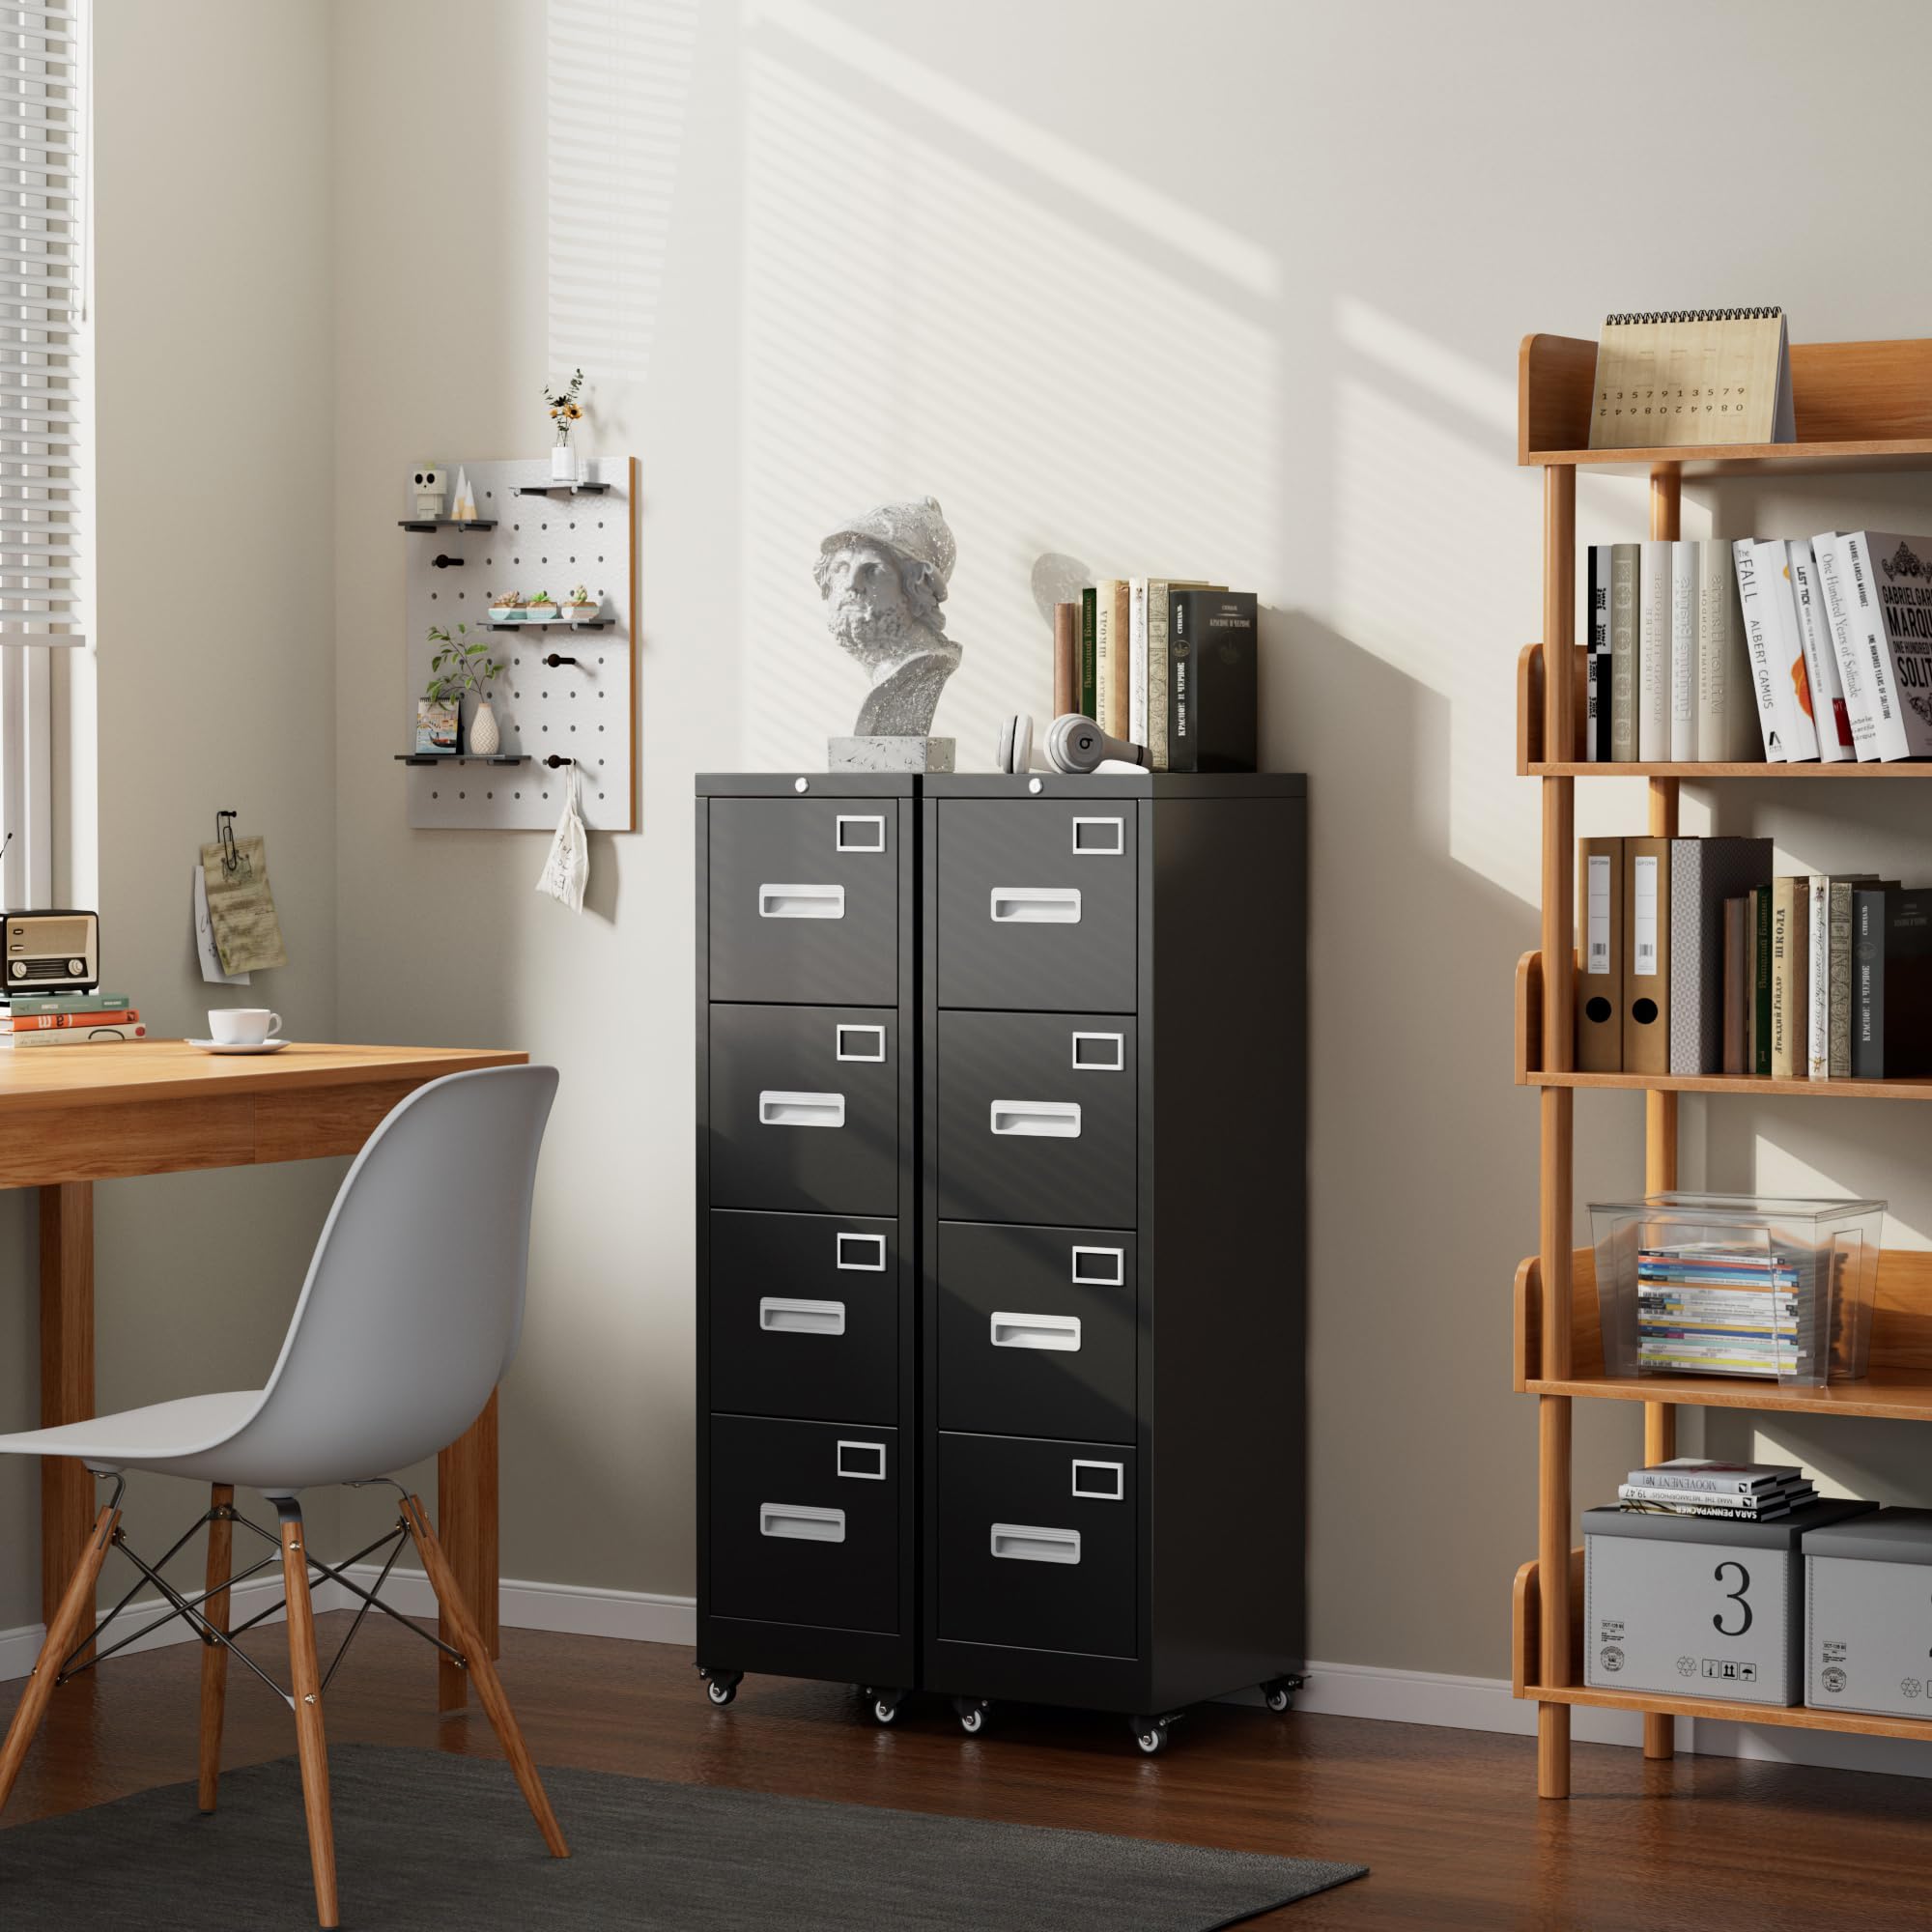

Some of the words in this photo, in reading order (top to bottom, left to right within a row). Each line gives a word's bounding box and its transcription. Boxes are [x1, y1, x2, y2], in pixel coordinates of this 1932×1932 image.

[1797, 566, 1807, 585] LAST
[1822, 554, 1833, 574] One
[1739, 559, 1758, 603] FALL
[1801, 588, 1810, 605] TICK
[1827, 576, 1846, 618] Hundred
[1882, 585, 1917, 605] GABRIEL
[1916, 587, 1932, 607] GAR
[1098, 611, 1107, 657] ШКОЛА
[1750, 620, 1767, 665] ALBERT
[1905, 641, 1930, 655] HUNDRED
[1758, 669, 1774, 709] CAMUS
[1843, 660, 1861, 697] Solitude
[1880, 696, 1891, 719] SOLITUDE
[1776, 909, 1785, 958] ШКОЛА
[1658, 1479, 1716, 1492] MOOVEMENT
[1676, 1506, 1733, 1518] PENNYPACKER
[1736, 1510, 1757, 1519] SARA
[1714, 1561, 1752, 1635] 3
